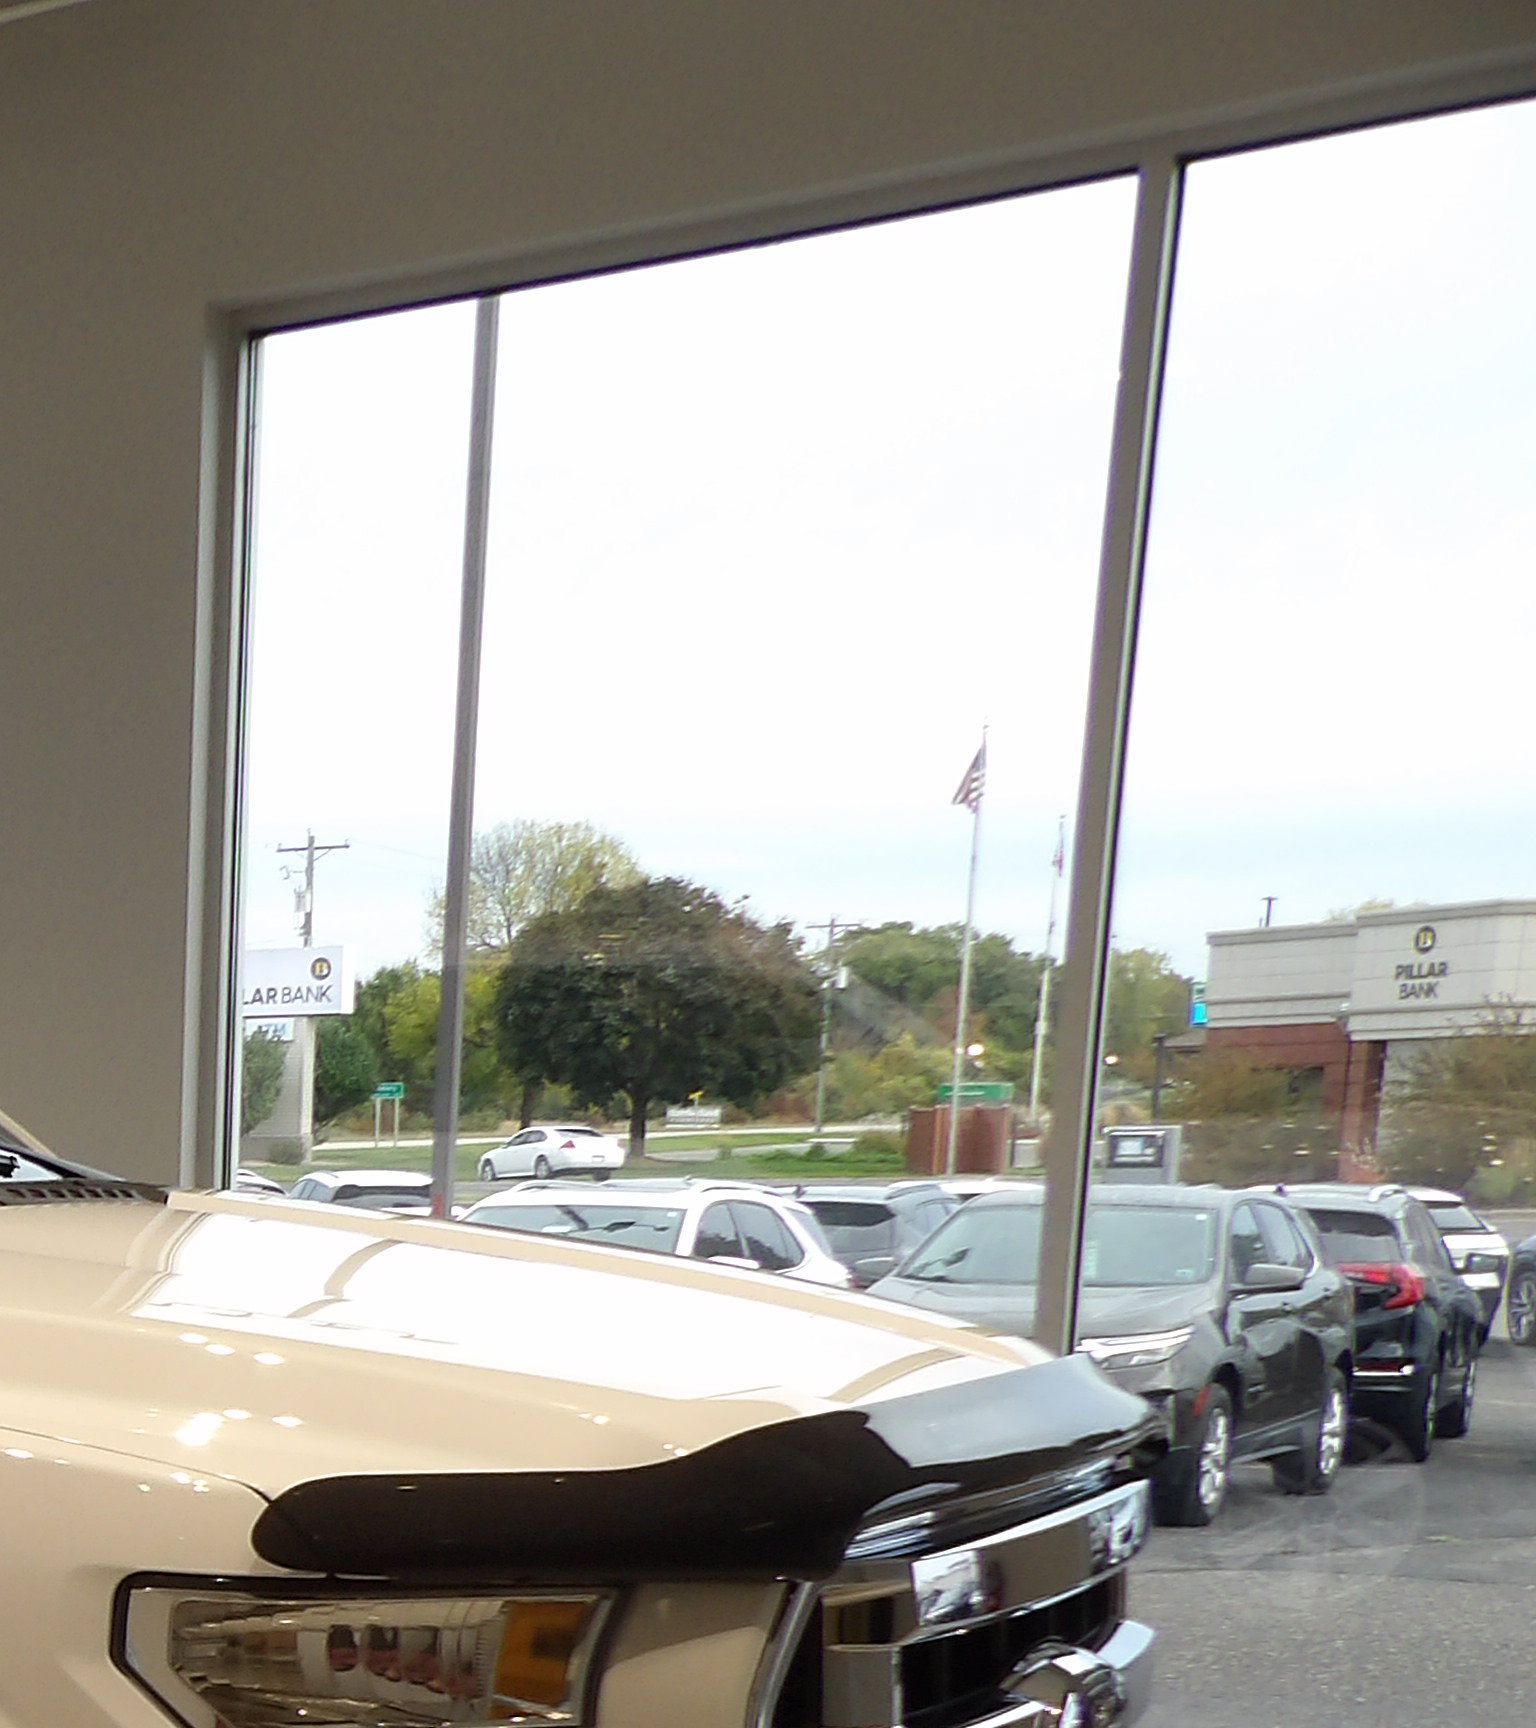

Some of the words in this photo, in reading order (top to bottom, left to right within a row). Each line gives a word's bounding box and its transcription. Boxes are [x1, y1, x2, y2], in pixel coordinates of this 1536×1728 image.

[1394, 962, 1447, 980] PILLAR
[281, 984, 333, 1004] BANK
[1399, 981, 1438, 1000] BANK
